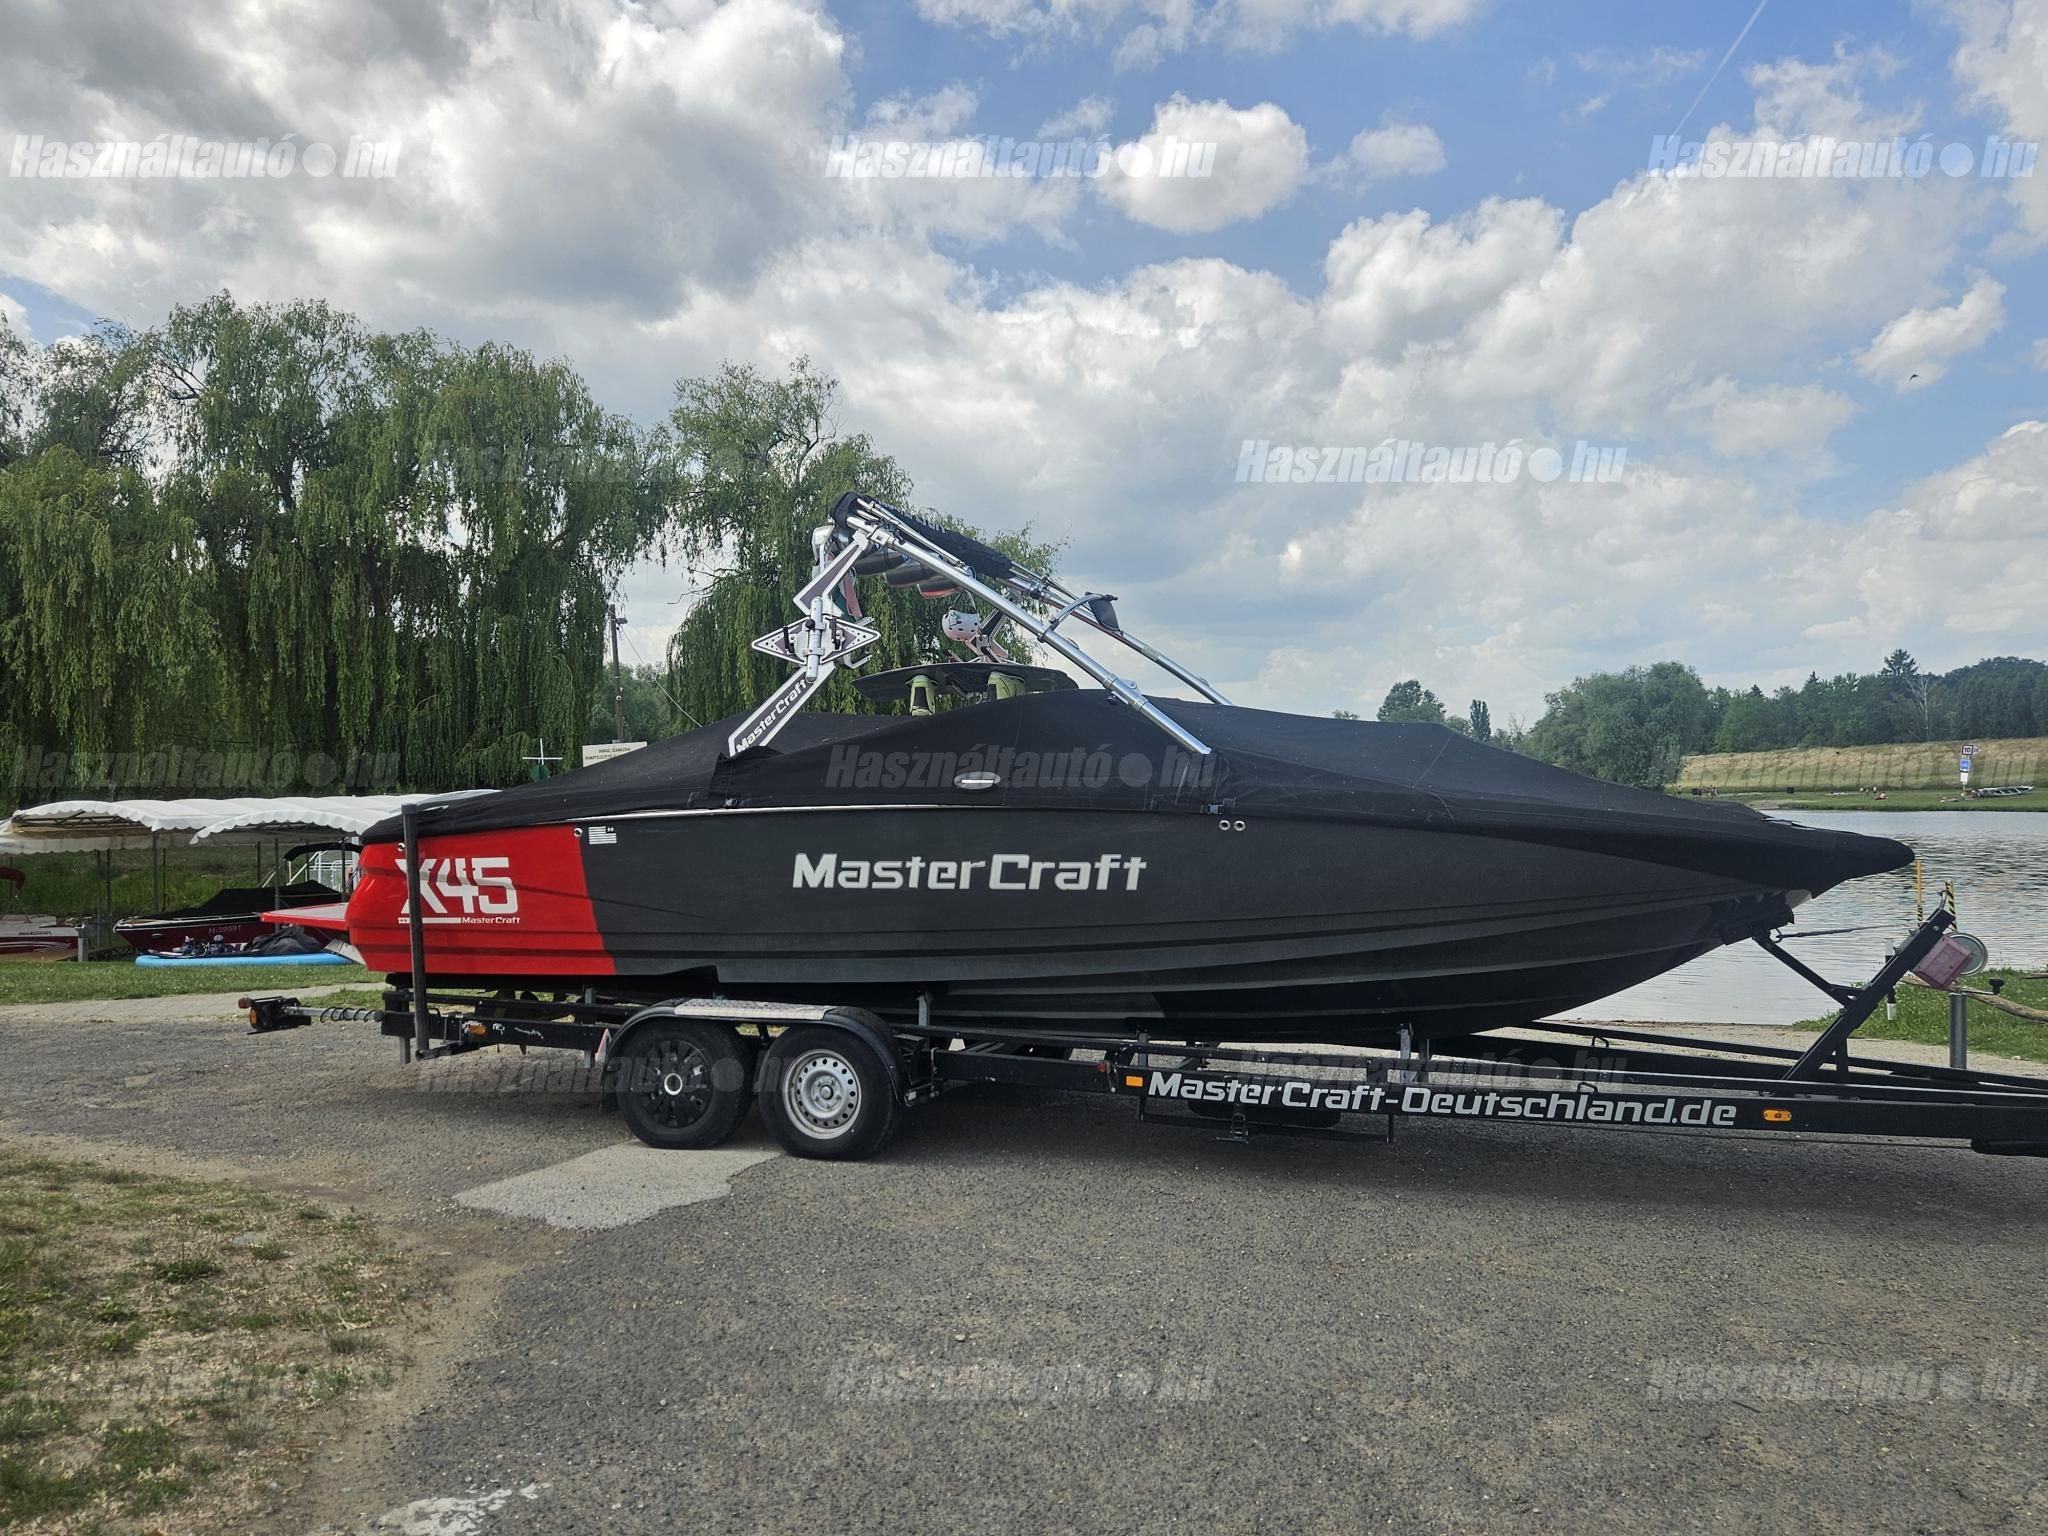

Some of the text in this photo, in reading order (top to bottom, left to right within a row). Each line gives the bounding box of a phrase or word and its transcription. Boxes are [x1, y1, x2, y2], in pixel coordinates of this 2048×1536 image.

[736, 679, 807, 753] MasterCraft
[394, 857, 519, 914] X45
[792, 853, 1147, 891] MasterCraft
[461, 916, 521, 925] MasterCraft
[1148, 1071, 1736, 1126] MasterCraft-Deutschland.de
